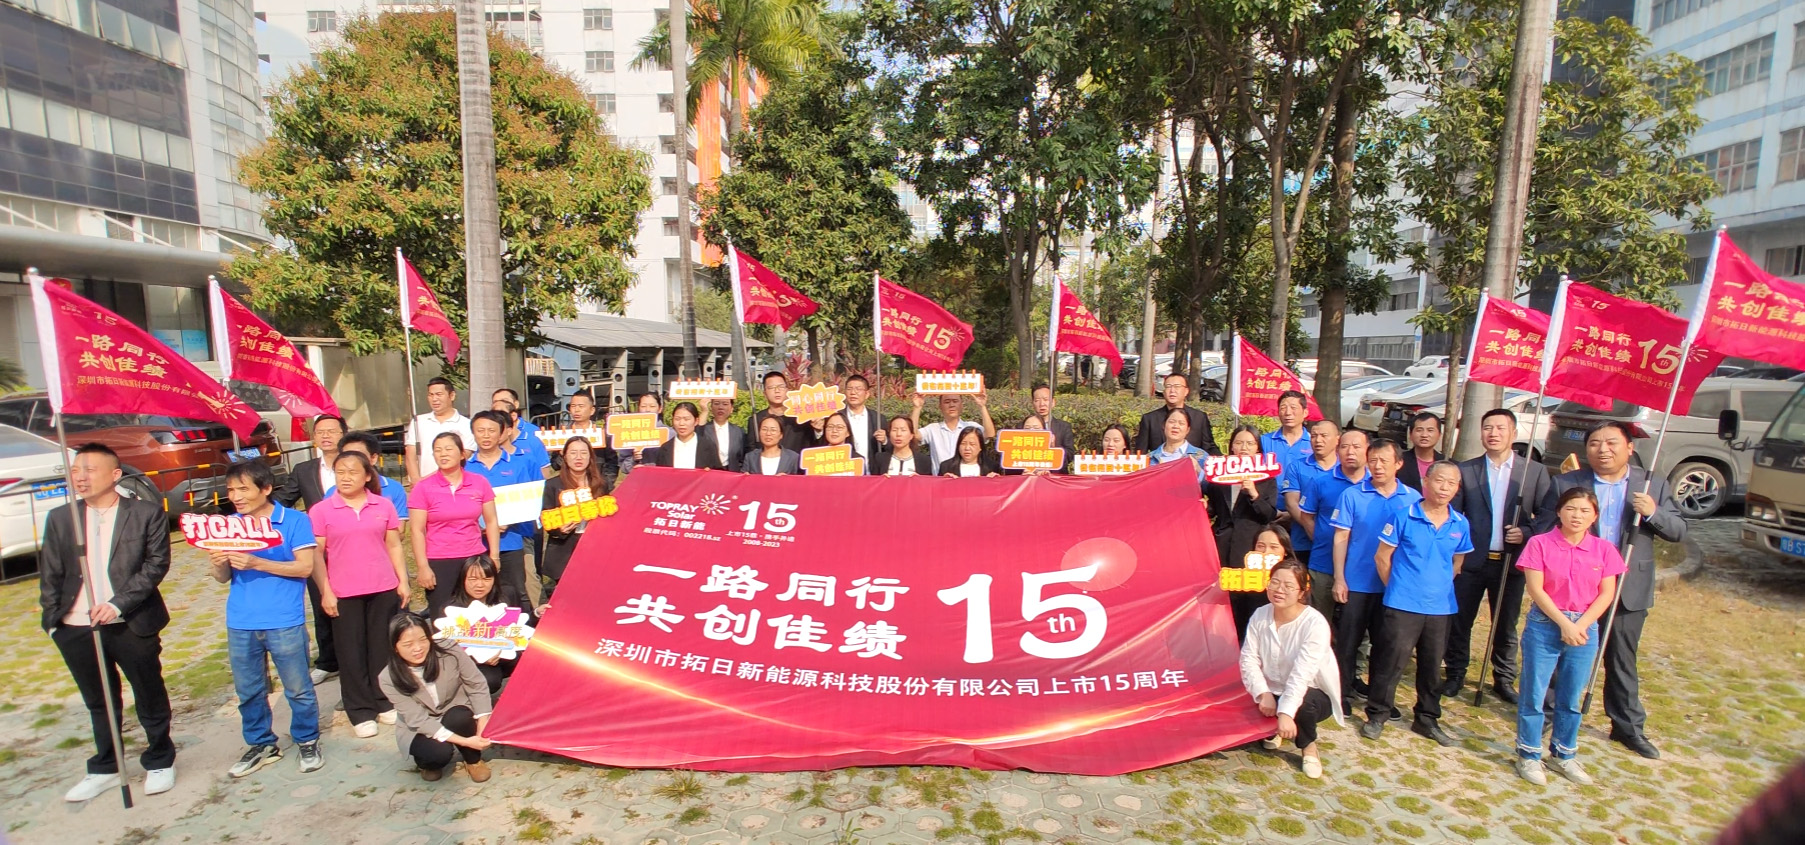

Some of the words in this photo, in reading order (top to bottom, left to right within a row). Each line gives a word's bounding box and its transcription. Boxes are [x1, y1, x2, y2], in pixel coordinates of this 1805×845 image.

[1510, 308, 1528, 319] 15
[1591, 300, 1611, 310] 15
[94, 311, 118, 327] 15
[882, 307, 923, 327] 一路同行
[922, 322, 956, 350] 15
[1489, 327, 1547, 345] 一路同
[1574, 325, 1632, 347] 一路同行
[75, 334, 169, 366] 一路同行
[1571, 338, 1632, 365] 共创佳绩
[1638, 338, 1684, 375] 15
[79, 351, 168, 379] 共创佳绩
[611, 418, 651, 429] 一路同行
[1002, 436, 1045, 447] 一路同行
[805, 450, 845, 462] 一路同行
[1011, 449, 1054, 460] 共创佳绩
[1206, 453, 1280, 476] 打CALL
[542, 496, 618, 530] 拓日等你
[650, 501, 699, 513] TOPRAY
[667, 510, 695, 520] Solar
[738, 500, 799, 533] 15
[774, 517, 785, 526] th
[181, 514, 280, 539] 打CALL
[654, 517, 706, 531] 拓日新能
[743, 538, 780, 548] 2008-2023
[632, 562, 910, 613] 一路同行
[1221, 568, 1271, 591] 拓日
[937, 564, 1109, 664] 15
[1046, 612, 1076, 635] th
[441, 621, 523, 639] 挑战新高度
[614, 593, 908, 661] 共创佳绩
[593, 637, 1189, 697] 深圳市拓日新能源科技股份有限公司上市15周年
